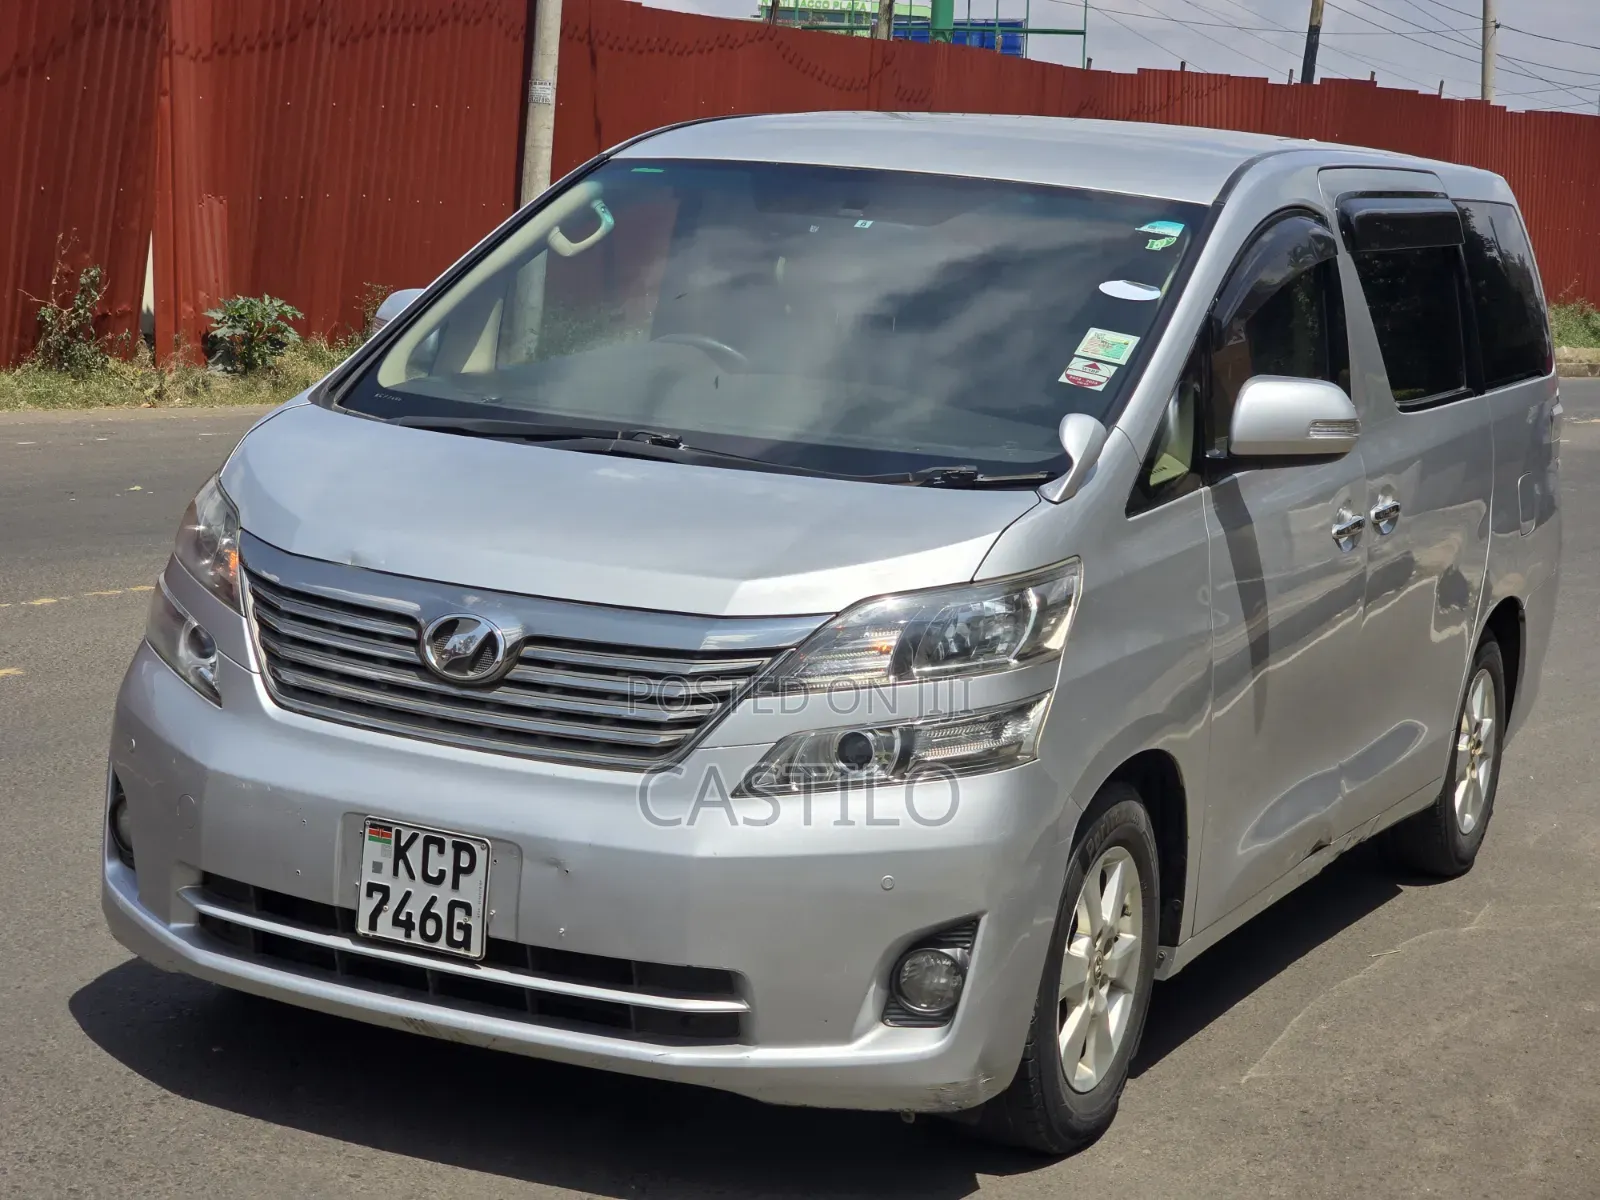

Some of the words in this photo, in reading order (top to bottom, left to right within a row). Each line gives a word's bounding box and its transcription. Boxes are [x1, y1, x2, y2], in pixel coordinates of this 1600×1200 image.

[794, 0, 831, 9] ACCO
[832, 1, 867, 11] PLAZA
[392, 828, 477, 891] KCP
[366, 881, 473, 952] 746G
